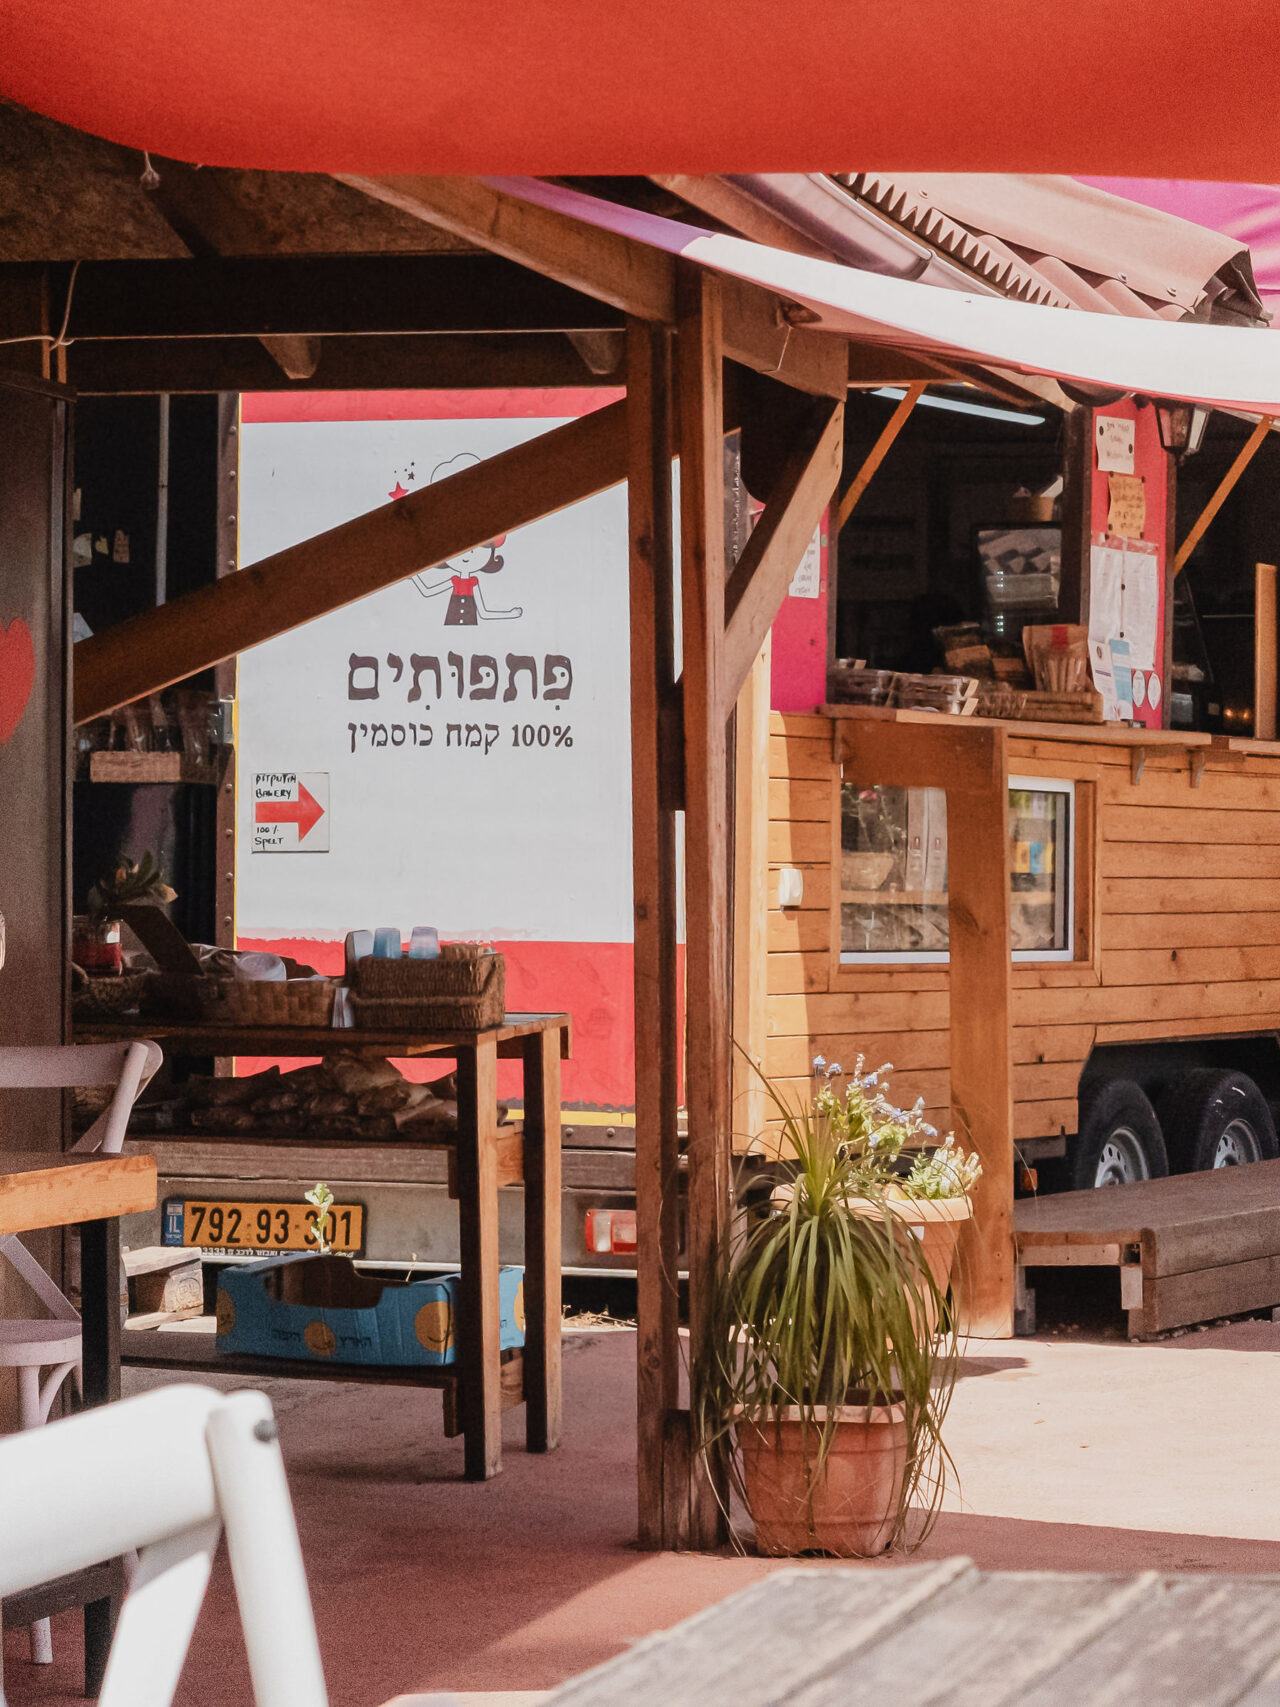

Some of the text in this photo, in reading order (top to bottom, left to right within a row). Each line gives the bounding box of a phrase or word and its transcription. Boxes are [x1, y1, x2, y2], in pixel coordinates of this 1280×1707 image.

[347, 722, 573, 755] 100% קמח כוסמין
